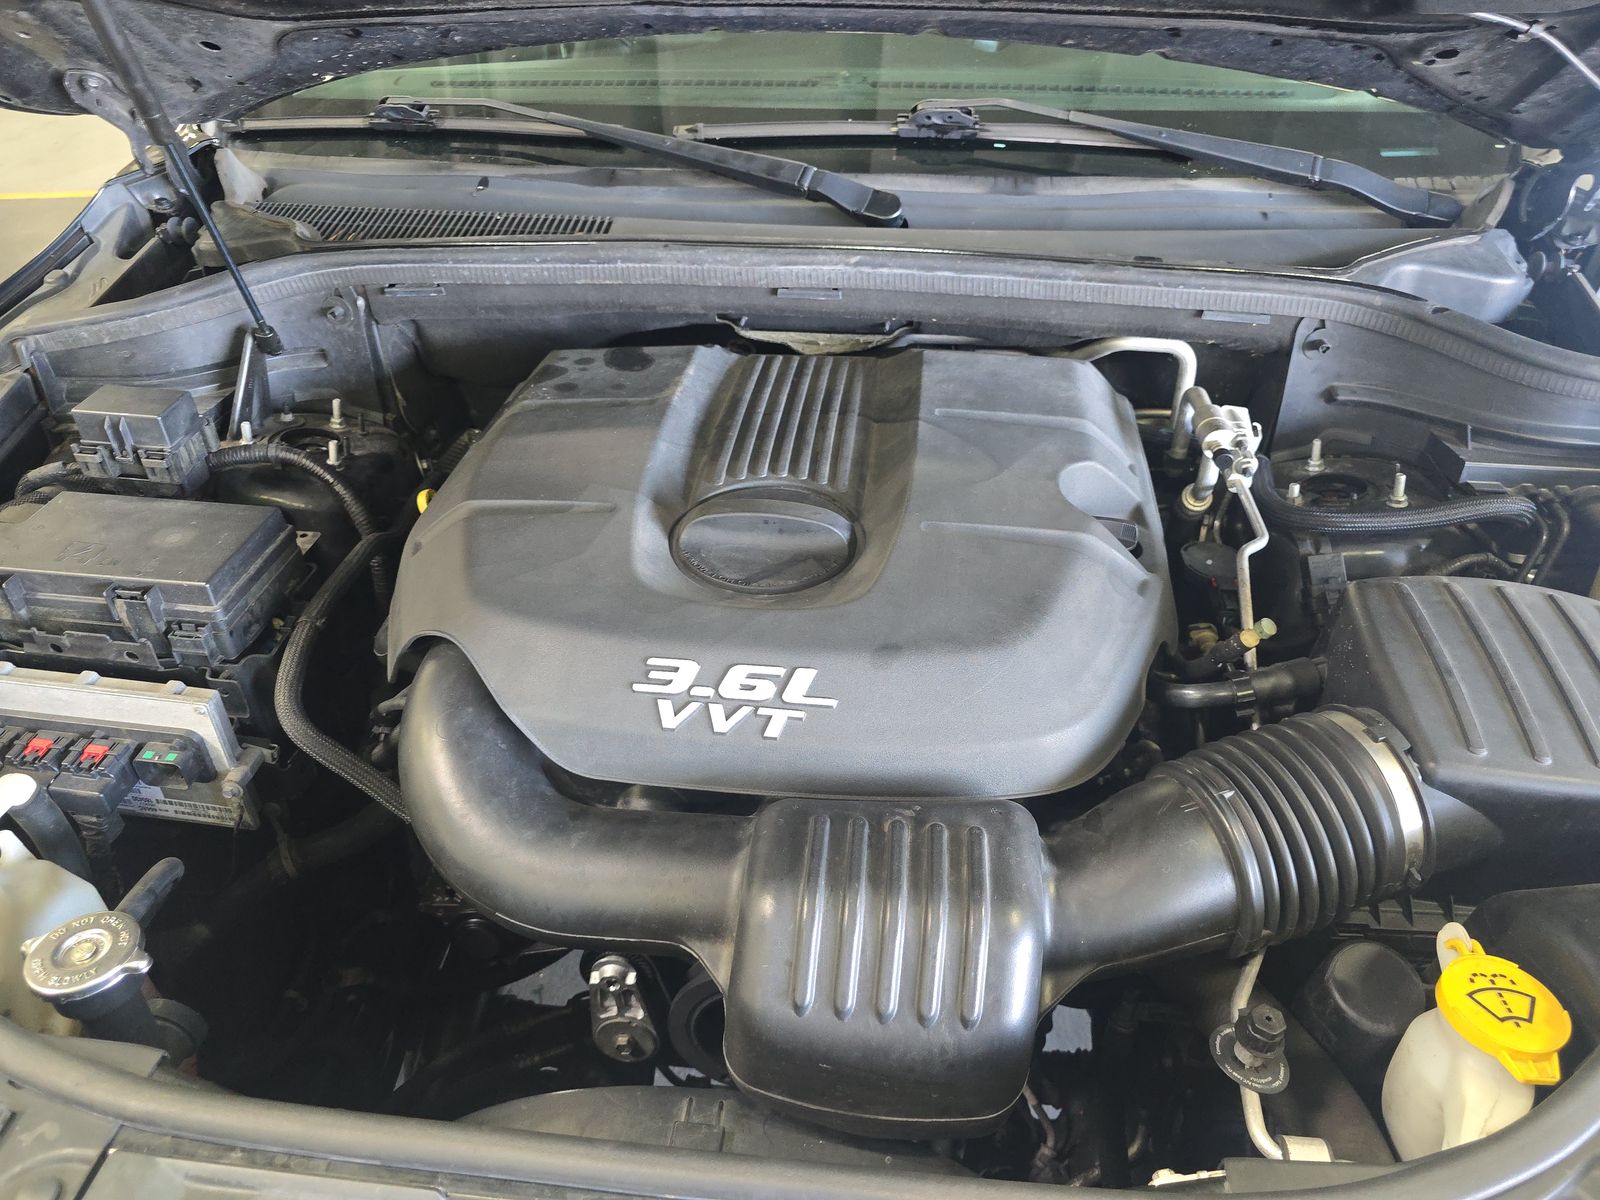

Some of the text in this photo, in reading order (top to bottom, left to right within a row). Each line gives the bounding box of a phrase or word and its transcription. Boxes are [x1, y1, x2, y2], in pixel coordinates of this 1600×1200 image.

[632, 657, 839, 709] 3.6L
[656, 698, 806, 740] VVT
[49, 927, 67, 940] DO
[71, 916, 97, 927] NOT
[101, 915, 128, 930] OPEN
